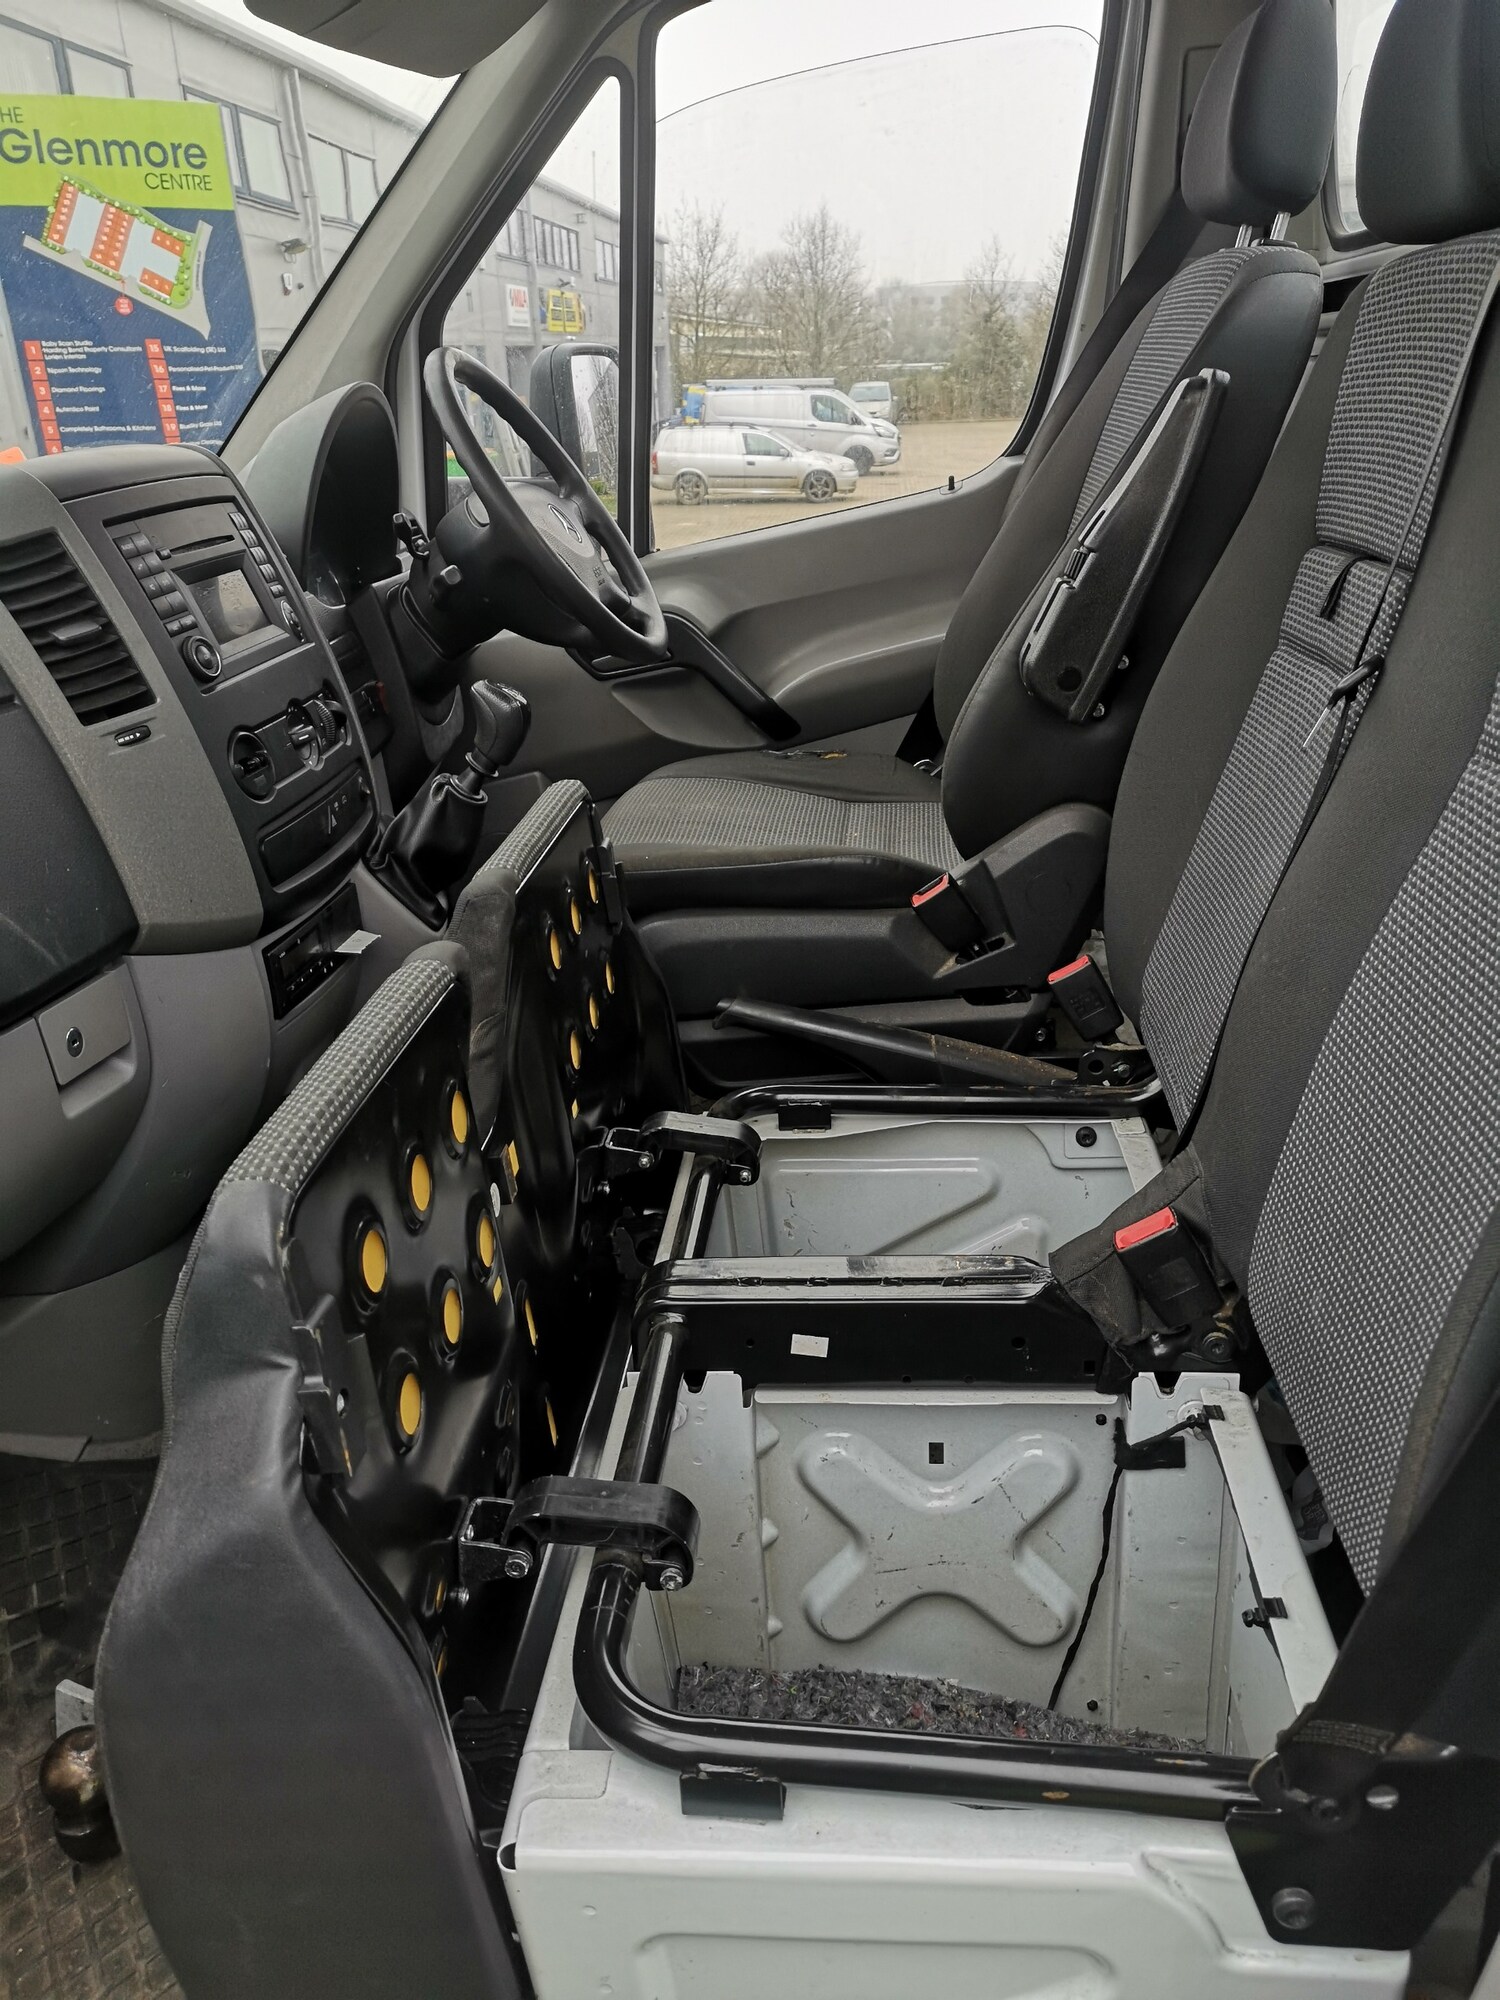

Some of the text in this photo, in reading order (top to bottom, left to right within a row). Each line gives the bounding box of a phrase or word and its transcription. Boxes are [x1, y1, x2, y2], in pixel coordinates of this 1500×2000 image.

[0, 128, 208, 170] Glenmore
[144, 172, 213, 191] CENTRE
[30, 346, 37, 355] 1
[84, 346, 108, 354] Property
[149, 344, 160, 353] 15
[173, 345, 205, 354] Scaffolding
[34, 366, 42, 375] 2
[69, 366, 103, 374] Technology
[154, 364, 165, 374] 16
[39, 386, 46, 395] 3
[158, 384, 168, 393] 17
[43, 406, 50, 415] 4
[161, 404, 172, 412] 18
[47, 426, 54, 435] 5
[132, 424, 157, 432] Kitchens
[165, 423, 176, 432] 19
